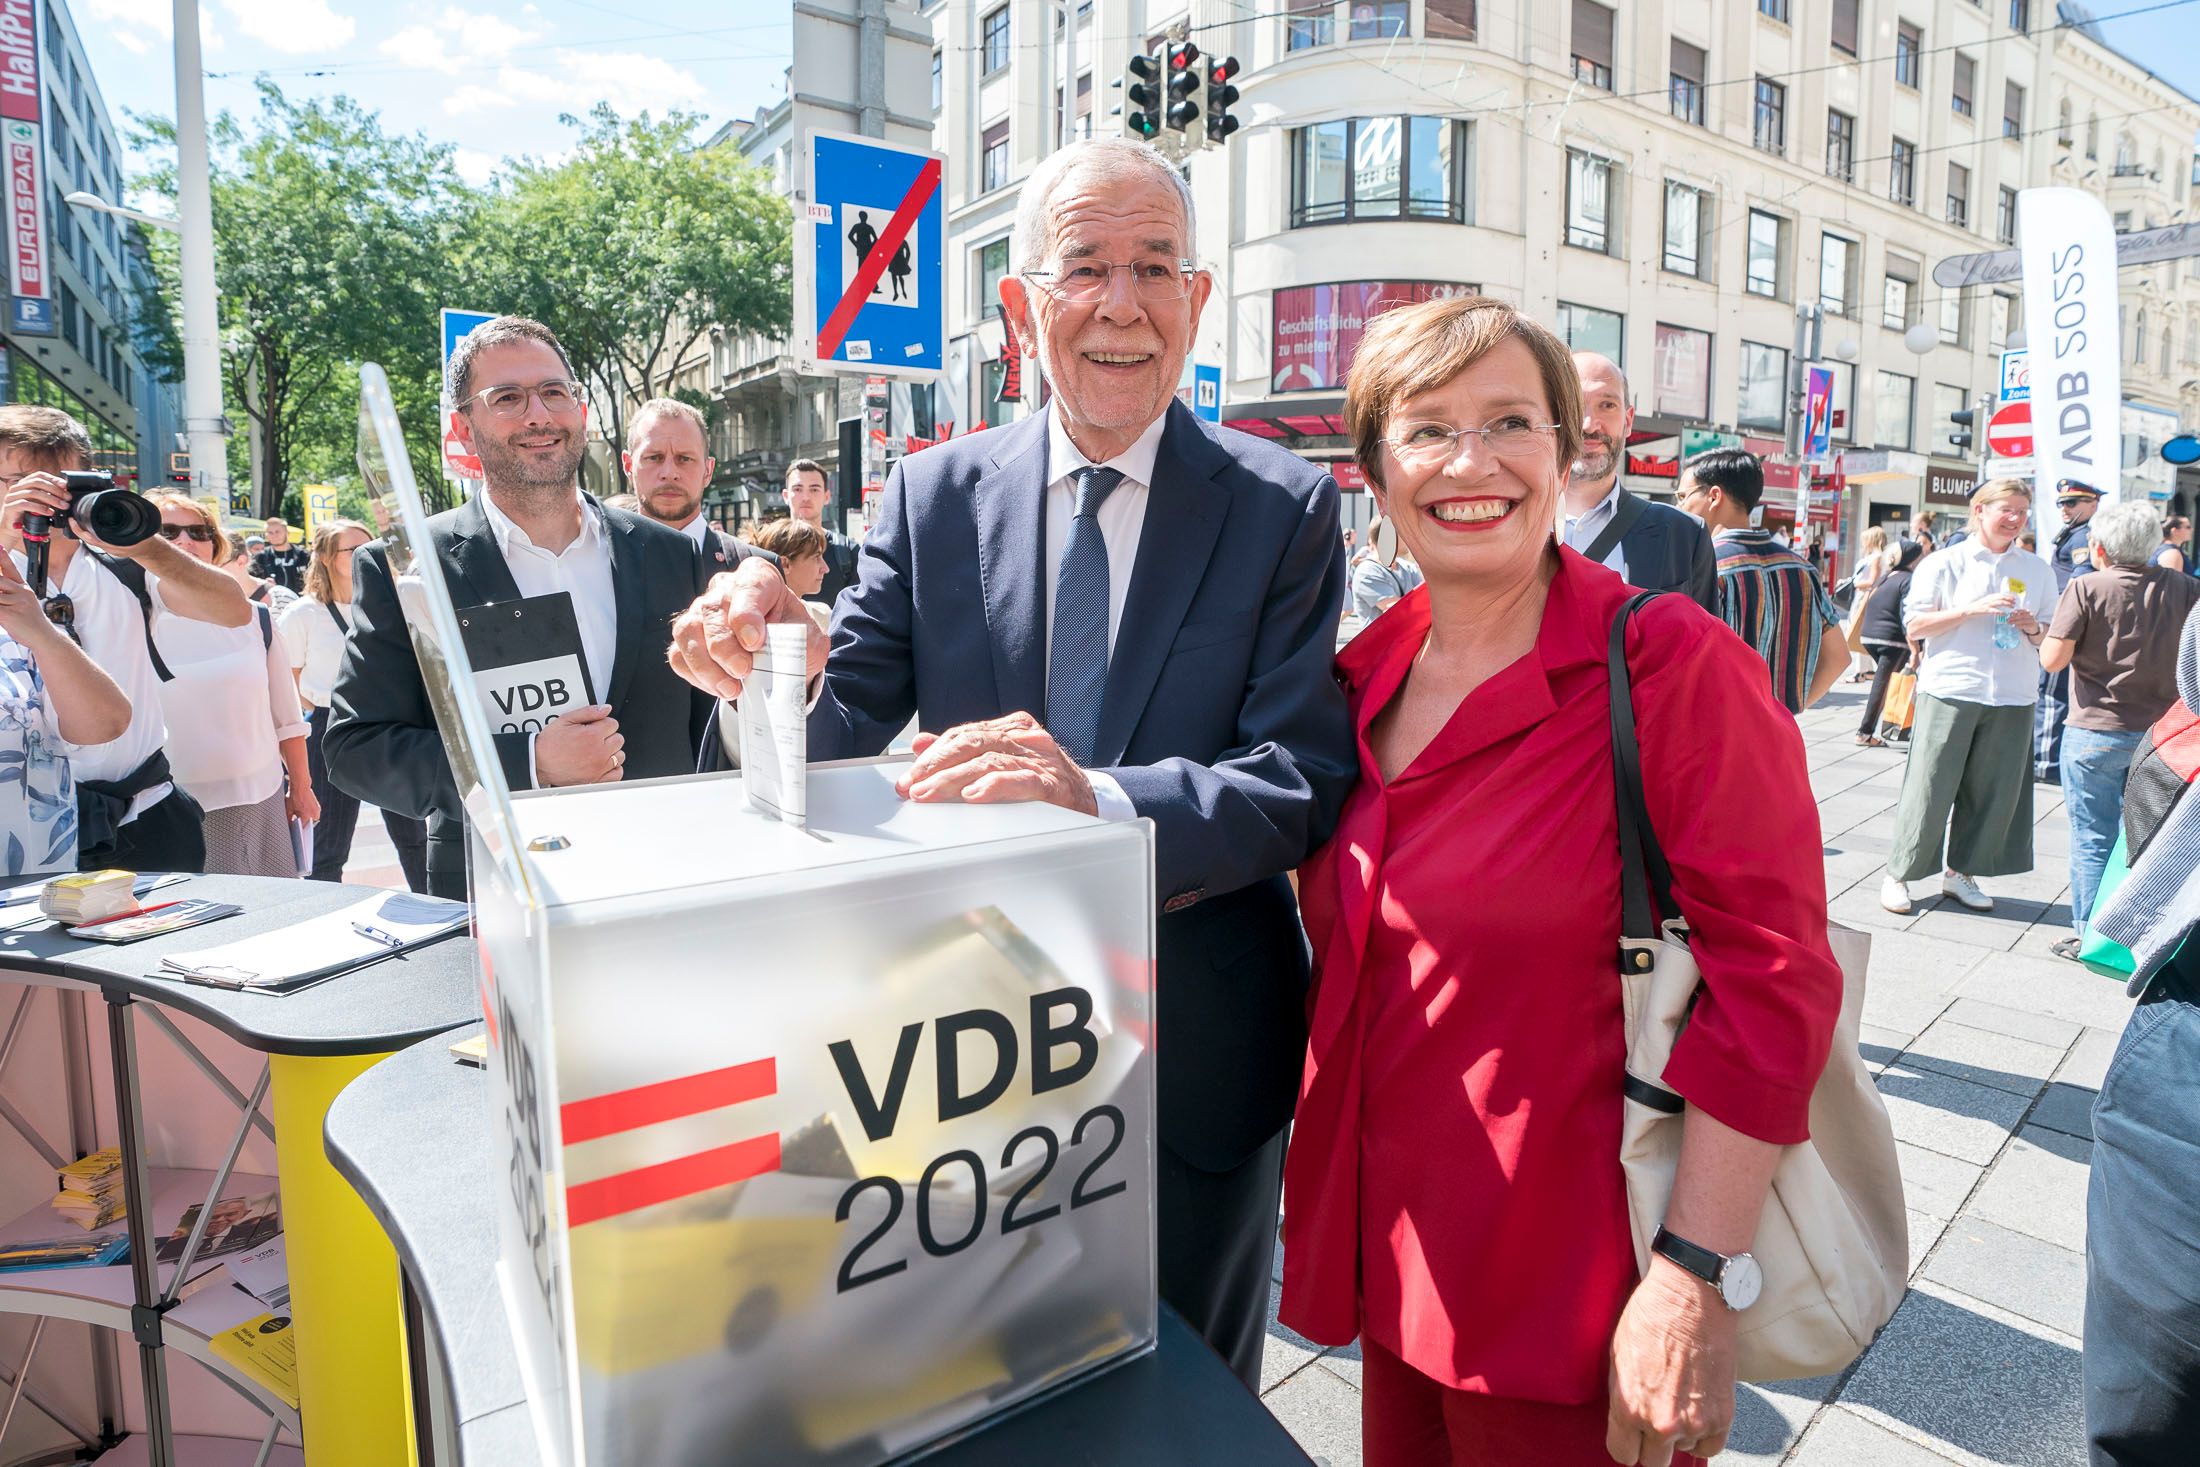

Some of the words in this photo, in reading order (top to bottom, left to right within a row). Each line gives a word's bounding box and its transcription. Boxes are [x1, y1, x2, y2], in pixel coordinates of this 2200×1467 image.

[0, 0, 36, 97] HalfPr
[14, 144, 38, 283] EUROSPAR
[490, 678, 570, 715] VDB
[827, 986, 1099, 1143] VDB
[835, 1104, 1127, 1295] 2022
